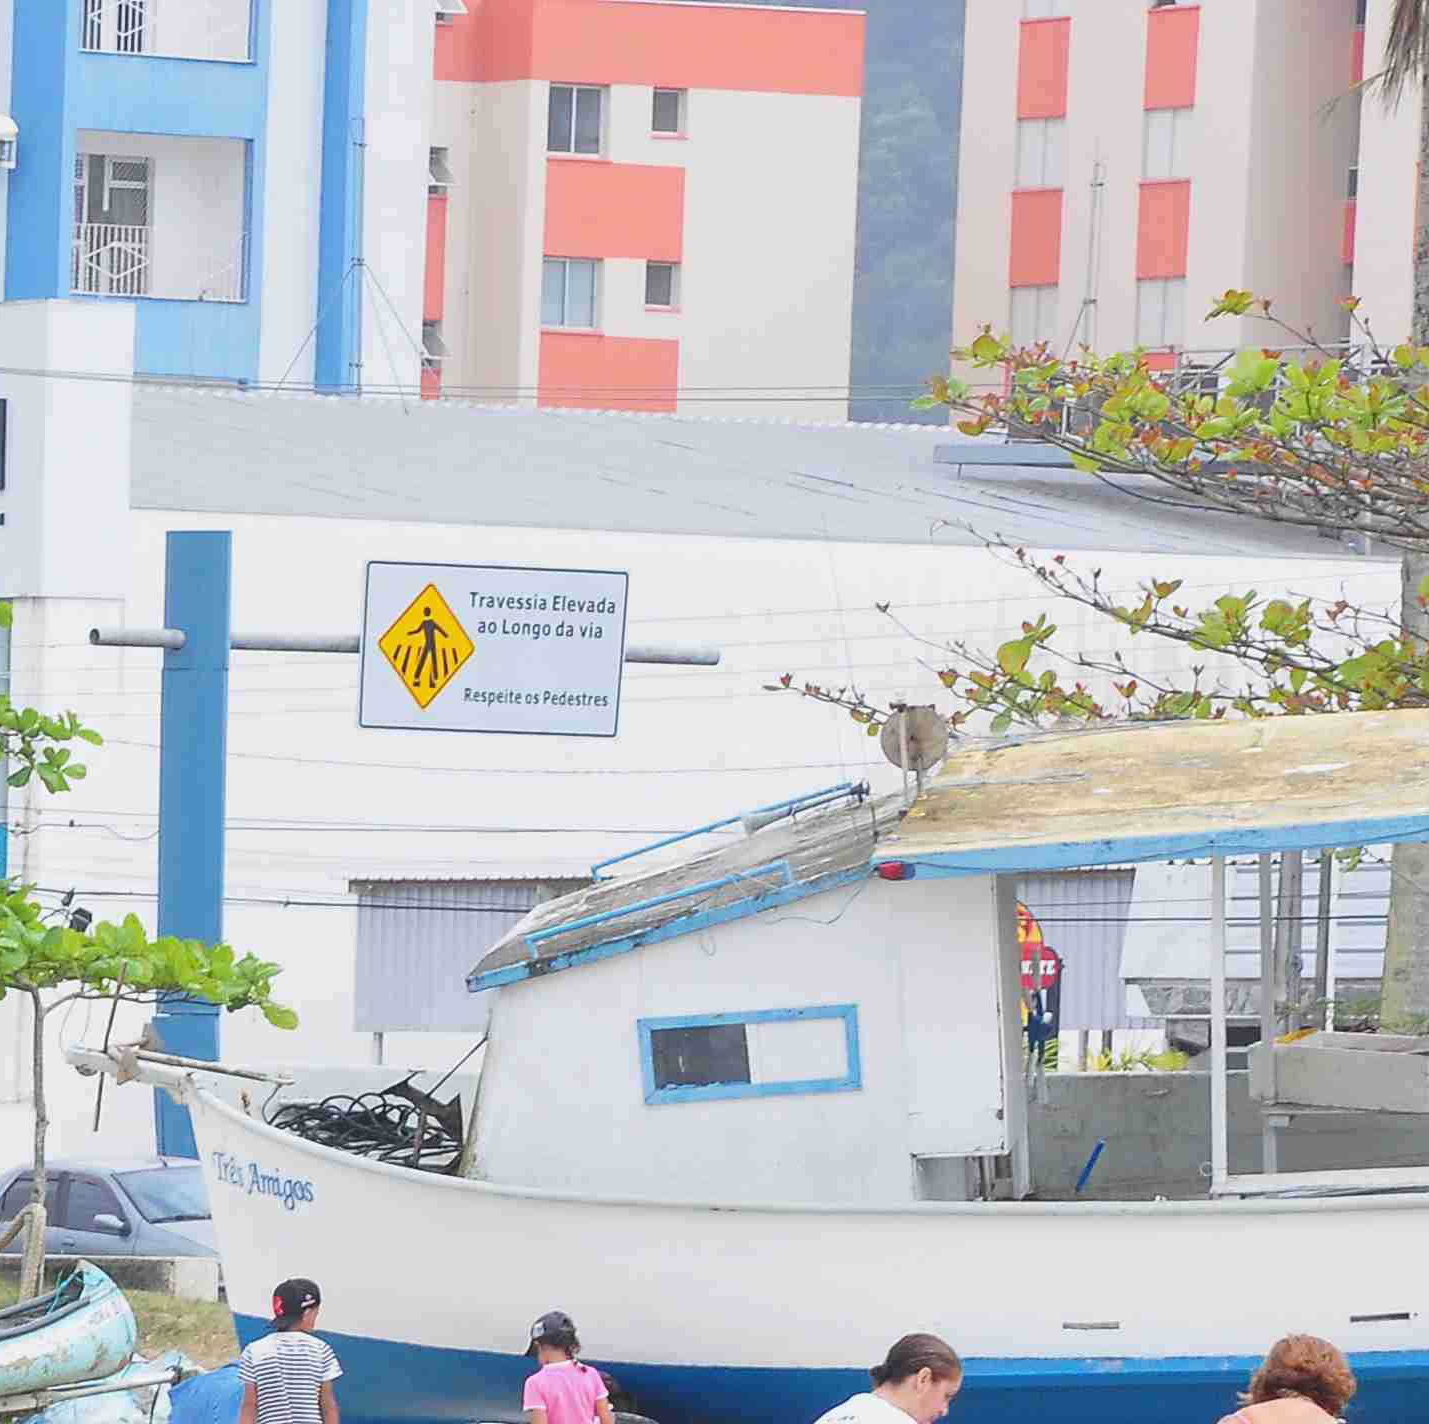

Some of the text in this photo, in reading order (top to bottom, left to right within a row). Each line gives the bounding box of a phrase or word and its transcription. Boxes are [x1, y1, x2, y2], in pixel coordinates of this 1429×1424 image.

[469, 591, 616, 615] Travessia Elevada
[477, 619, 603, 641] ao Longo da via
[464, 688, 609, 707] Respeite os Pedestres
[247, 1161, 314, 1210] Amigos
